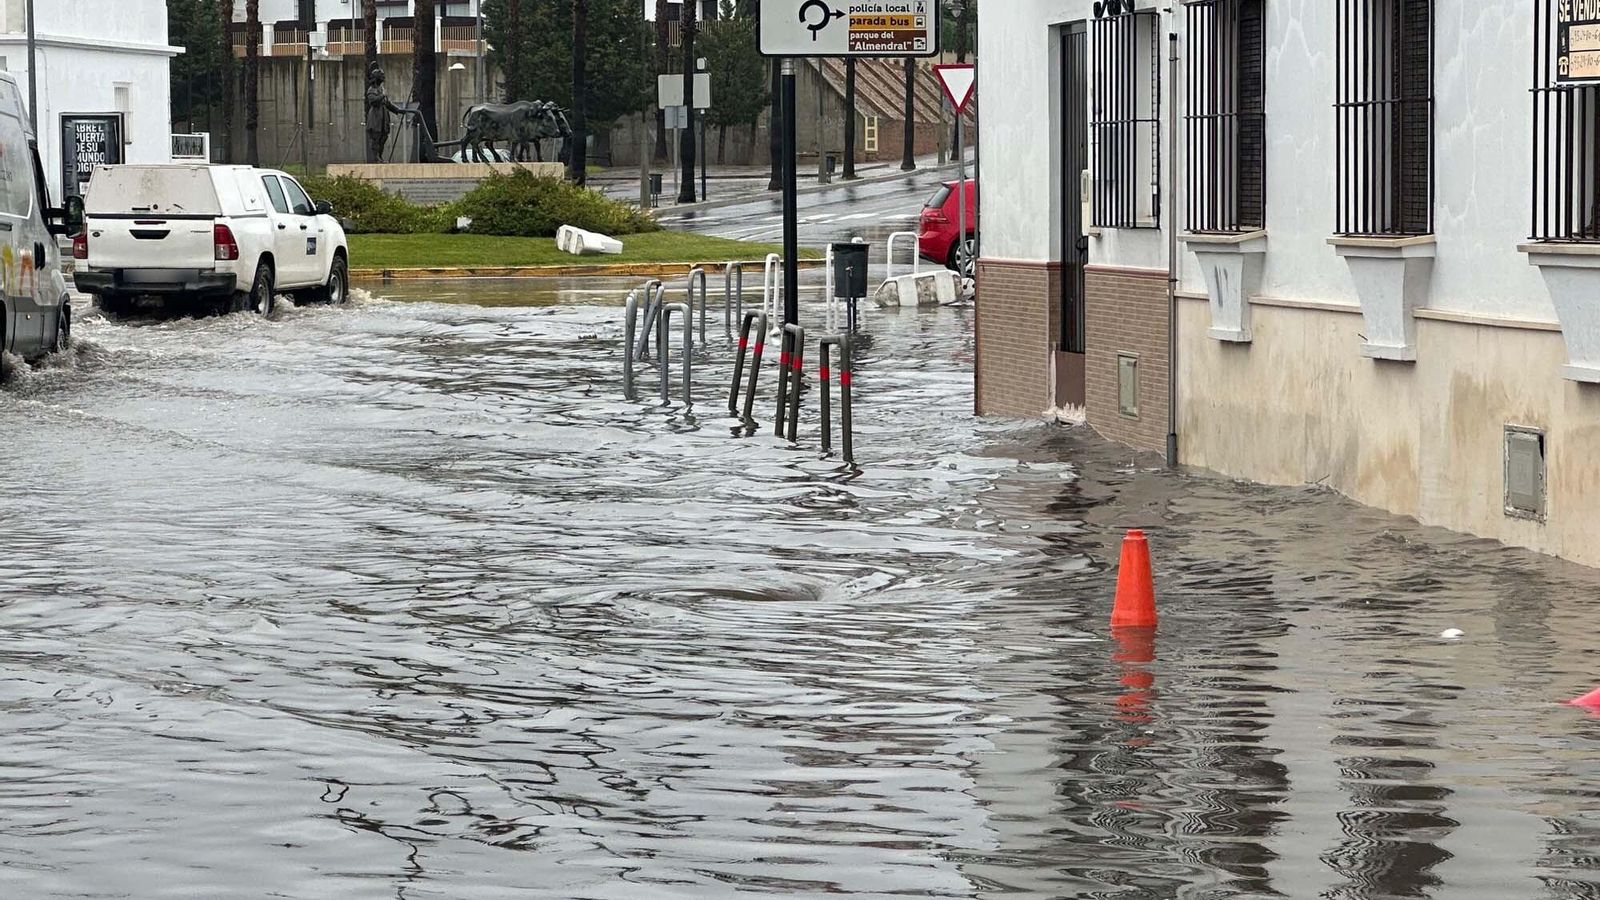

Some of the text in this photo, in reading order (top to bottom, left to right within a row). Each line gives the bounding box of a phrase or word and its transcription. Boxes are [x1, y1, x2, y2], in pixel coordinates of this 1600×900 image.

[849, 3, 910, 14] policía local
[1559, 0, 1570, 22] SE
[849, 16, 909, 26] parada bus
[850, 31, 894, 40] parque del
[86, 142, 98, 152] SU
